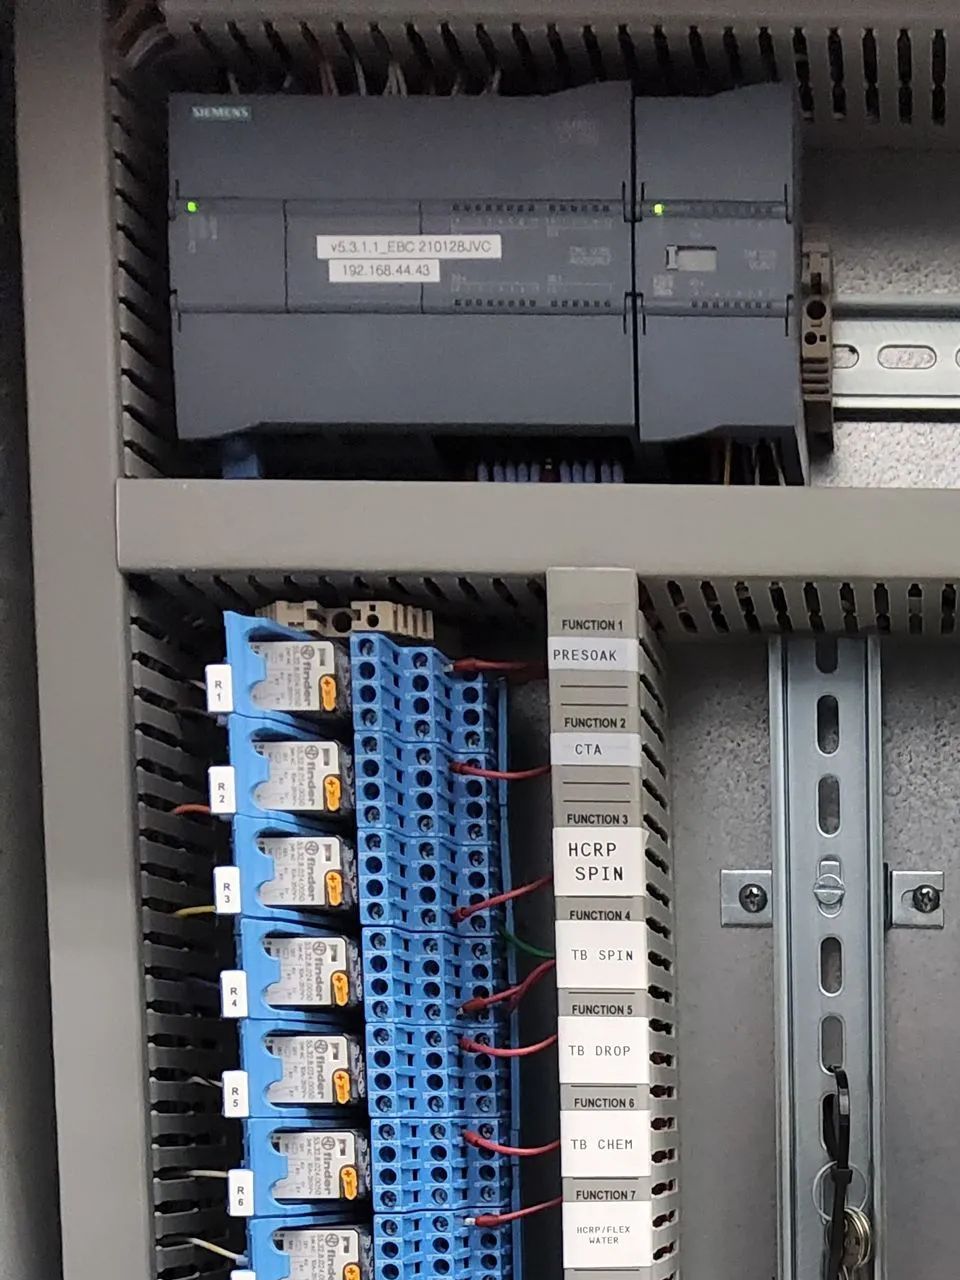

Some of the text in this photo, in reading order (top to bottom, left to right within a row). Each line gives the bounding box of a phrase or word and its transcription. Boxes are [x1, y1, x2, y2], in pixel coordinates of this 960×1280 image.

[192, 106, 249, 118] SIEMENS
[331, 240, 493, 255] v5.3.1.1_EBC 210128JVC
[343, 264, 431, 277] 192.168.44.43
[561, 619, 623, 631] FUNCTION 1
[553, 649, 617, 661] PRESOAK
[303, 661, 312, 706] finder
[564, 717, 626, 728] FUNCTION 2
[575, 743, 602, 755] CTA
[306, 761, 315, 806] finder
[567, 814, 628, 825] FUNCTION 3
[568, 842, 617, 857] HCRP
[575, 866, 624, 881] SPIN
[306, 858, 315, 902] finder
[569, 910, 631, 921] FUNCTION 4
[571, 949, 633, 961] TB SPIN
[315, 957, 324, 1002] finder
[572, 1004, 633, 1015] FUNCTION 5
[568, 1045, 631, 1056] TB DROP
[574, 1097, 635, 1108] FUNCTION 6
[570, 1139, 633, 1150] TB CHEM
[576, 1190, 636, 1200] FUNCTION 7
